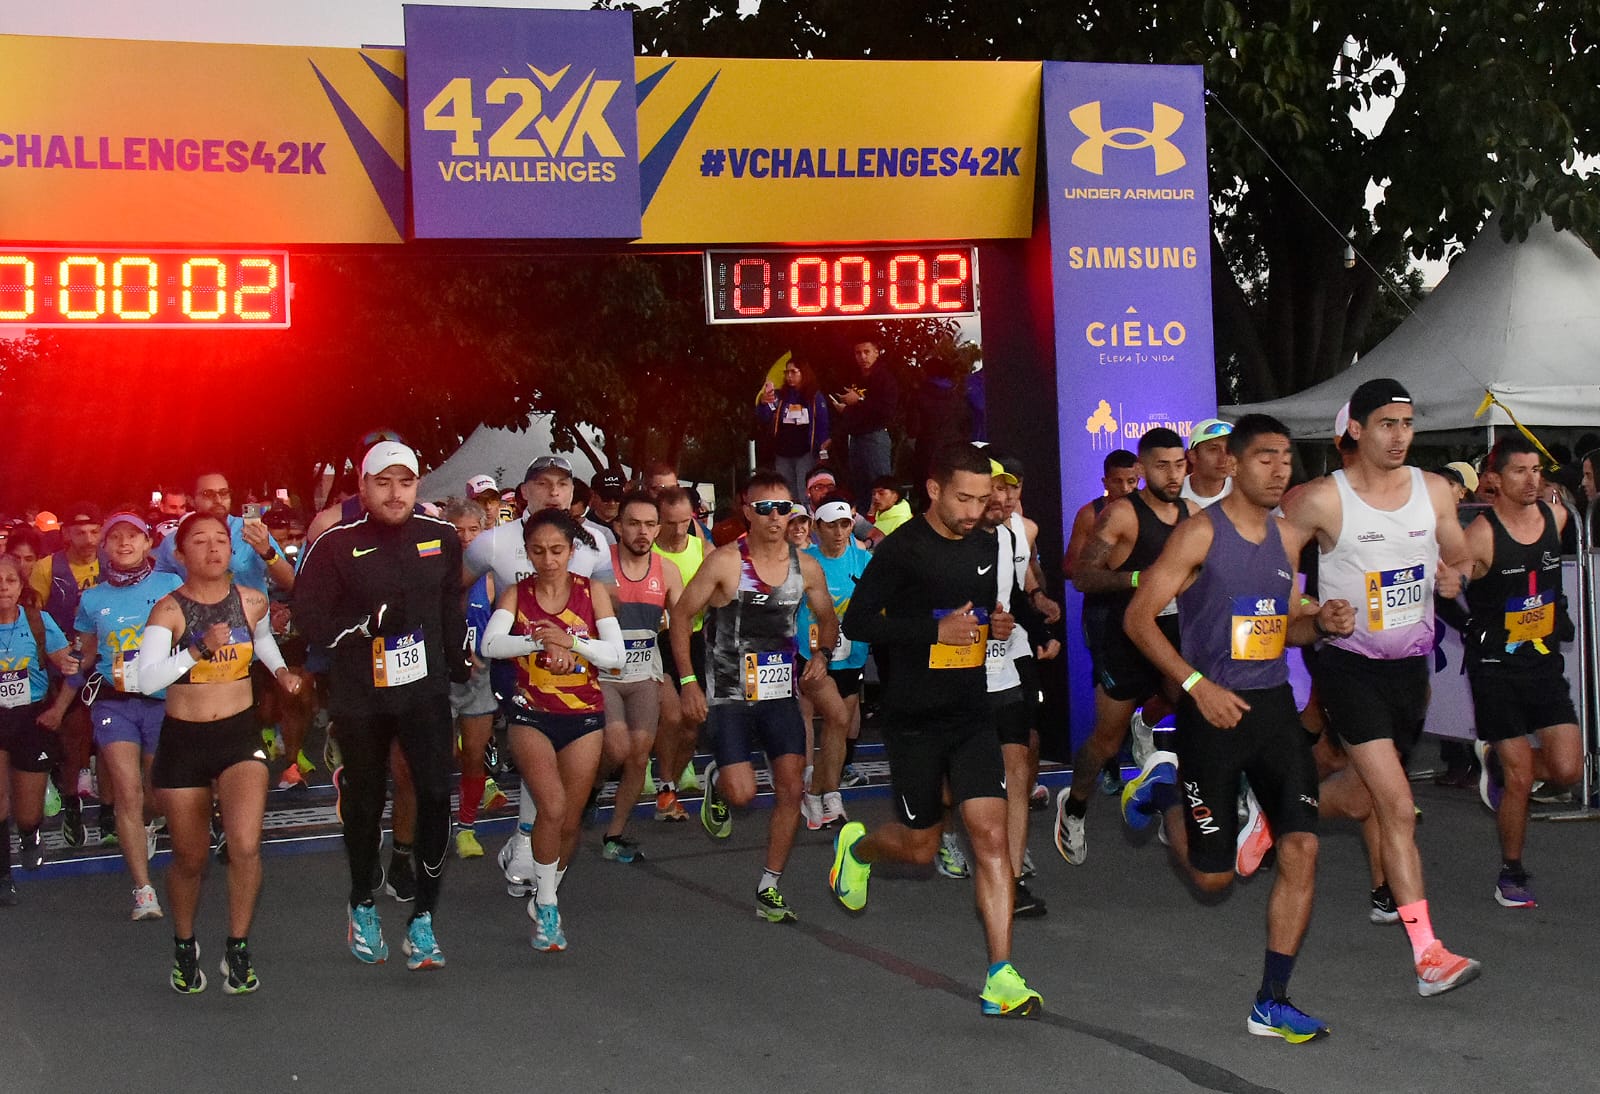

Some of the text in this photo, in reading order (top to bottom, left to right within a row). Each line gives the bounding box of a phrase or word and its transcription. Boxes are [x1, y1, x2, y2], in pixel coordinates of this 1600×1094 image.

[423, 63, 626, 159] 42K
[438, 160, 617, 183] VCHALLENGES
[700, 147, 1022, 179] #VCHALLENGES42K
[1064, 188, 1195, 200] UNDER ARMOUR
[1069, 246, 1197, 270] SAMSUNG
[1369, 579, 1378, 593] A
[1386, 584, 1421, 608] 5210
[1517, 609, 1545, 625] JOSE
[394, 648, 419, 668] 138
[625, 649, 652, 664] 2216
[759, 667, 790, 684] 2223
[0, 682, 25, 698] 962
